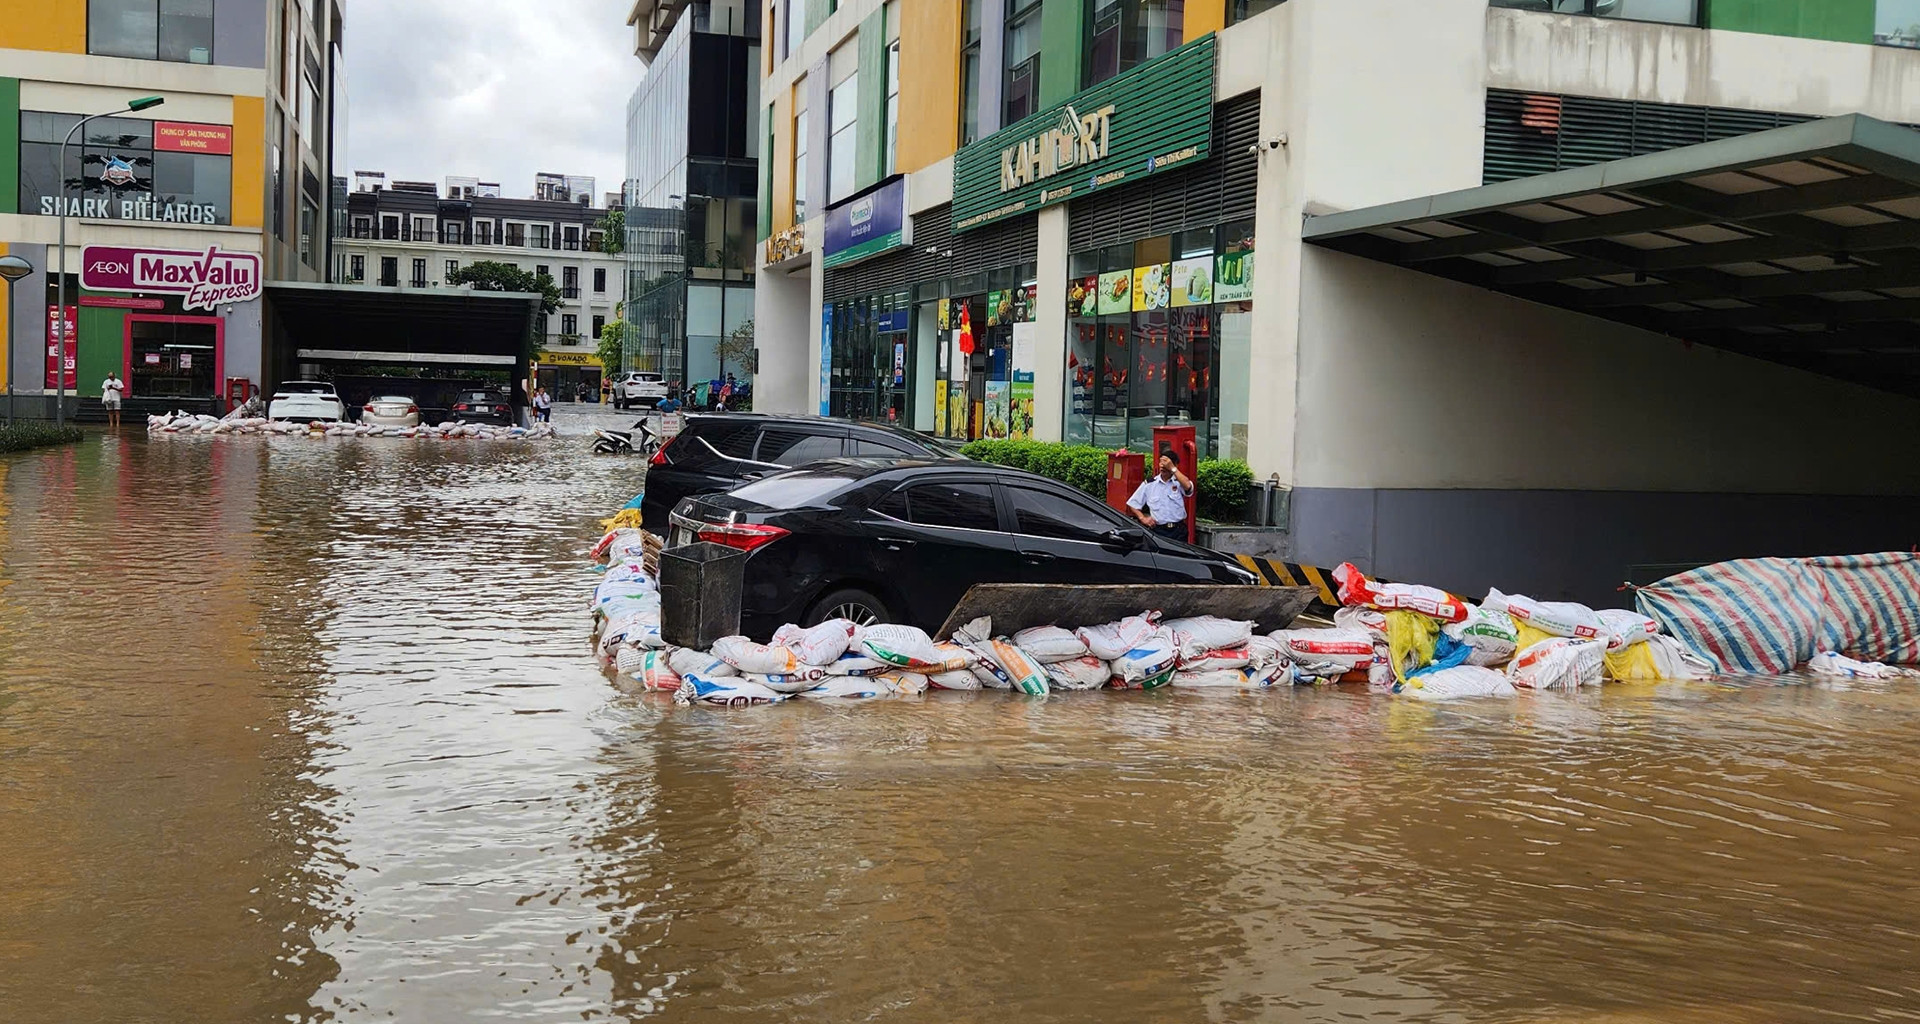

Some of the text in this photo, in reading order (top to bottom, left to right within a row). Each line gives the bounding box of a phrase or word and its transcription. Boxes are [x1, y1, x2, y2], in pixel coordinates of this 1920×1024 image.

[41, 196, 109, 218] SHARK
[140, 246, 249, 285] MaxValu
[188, 283, 253, 309] Express
